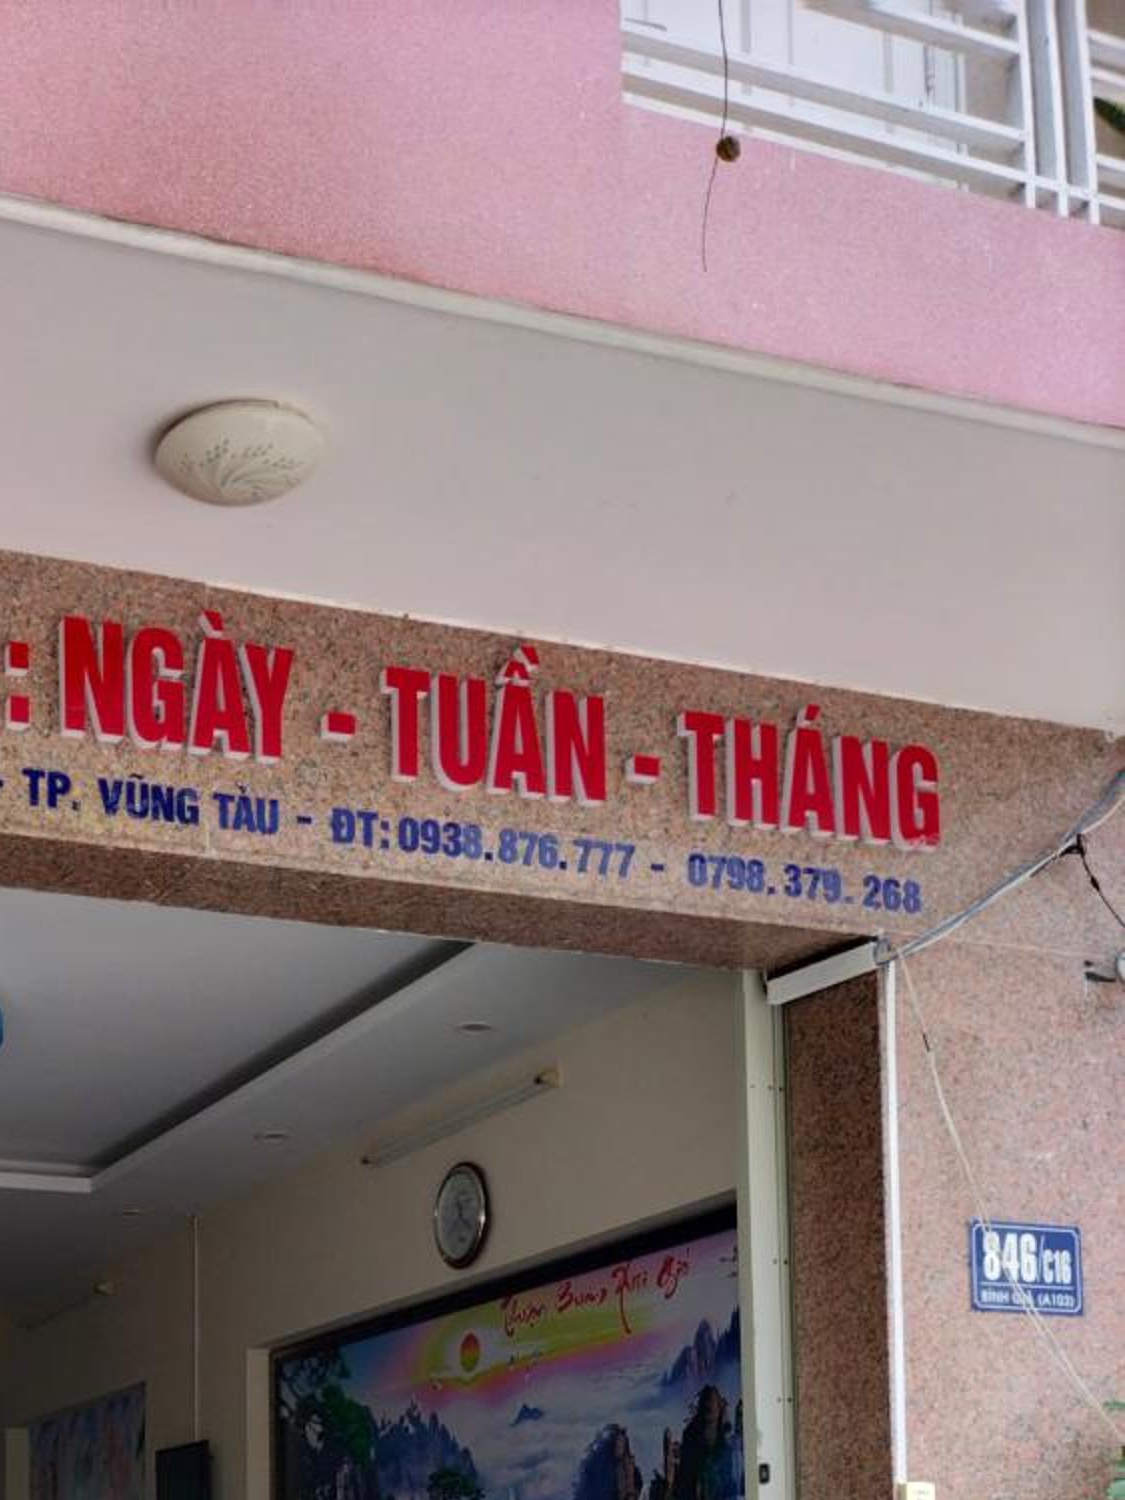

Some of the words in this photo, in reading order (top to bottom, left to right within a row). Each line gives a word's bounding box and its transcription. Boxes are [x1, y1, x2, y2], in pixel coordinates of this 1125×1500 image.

[22, 767, 81, 812] TP.
[98, 773, 200, 826] VŨNG
[212, 781, 279, 835] TÀU
[60, 609, 295, 764] NGÀY
[379, 645, 608, 807] TUẦN
[678, 704, 941, 852] THÁNG
